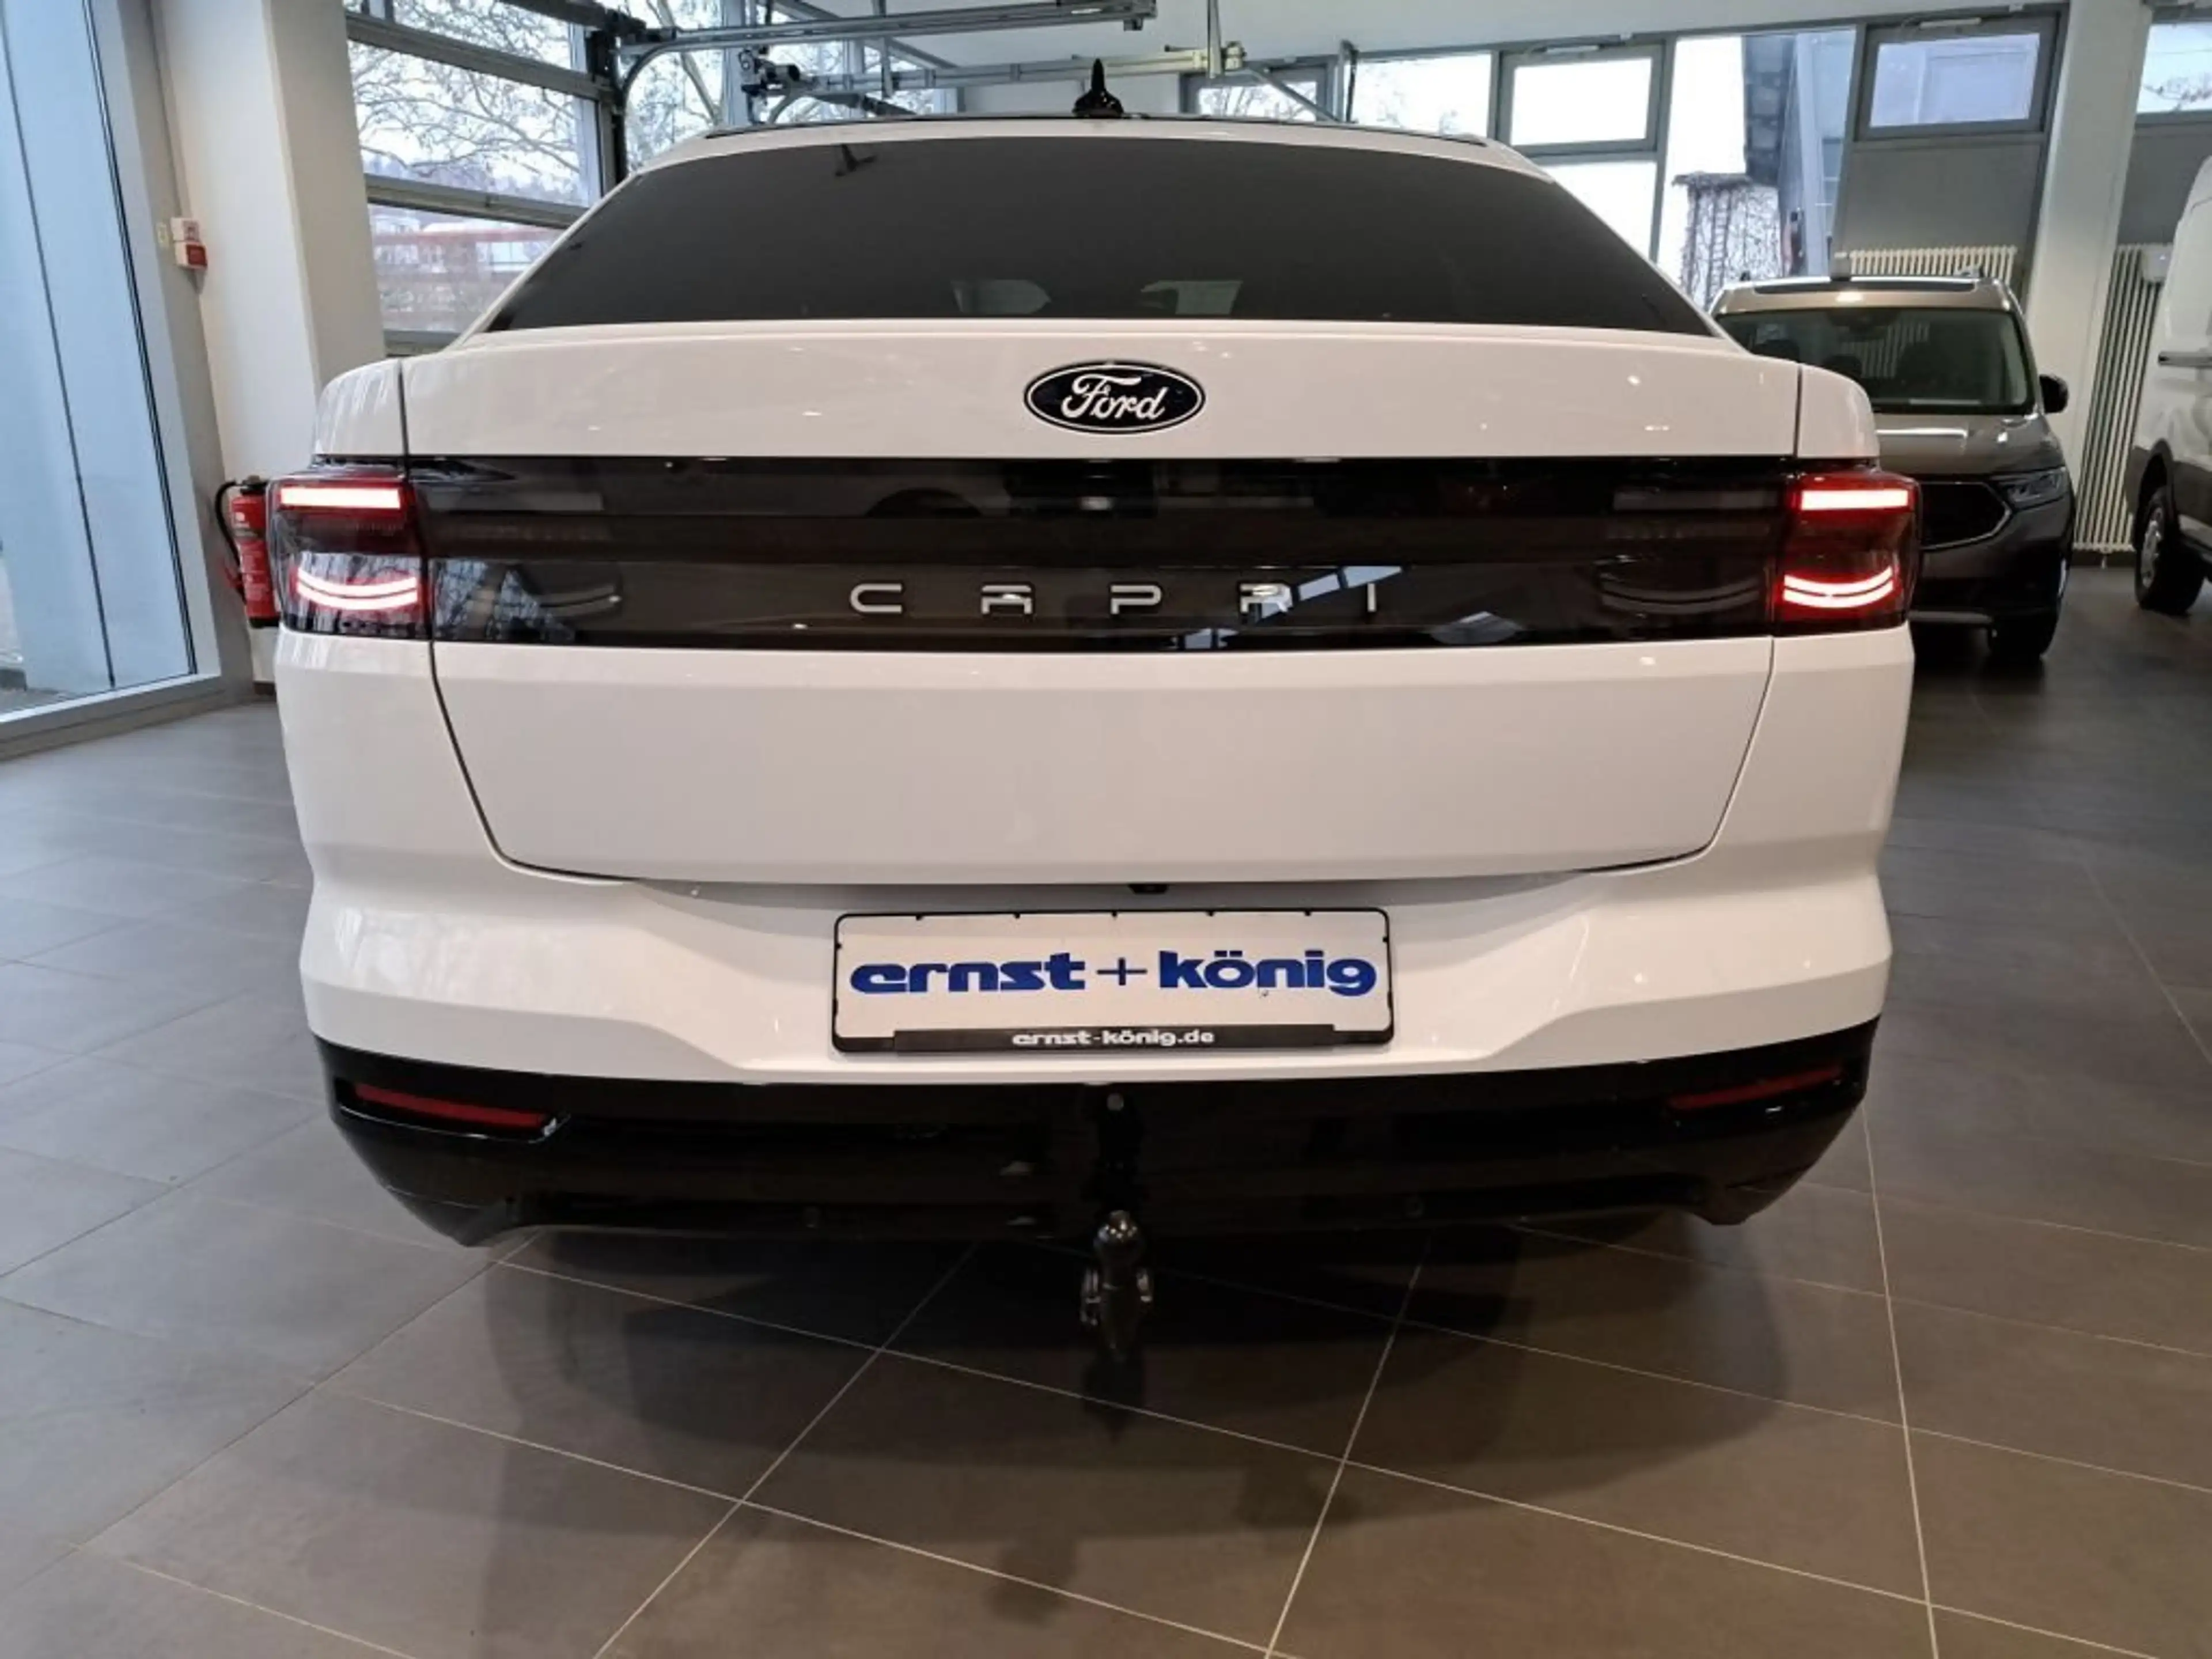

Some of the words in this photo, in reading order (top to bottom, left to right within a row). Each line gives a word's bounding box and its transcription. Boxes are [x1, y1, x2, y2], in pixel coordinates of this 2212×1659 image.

[1062, 373, 1167, 421] Ford
[850, 582, 1376, 615] CAPRI
[850, 952, 1086, 995] ernst
[1158, 950, 1377, 997] könig
[1012, 1028, 1215, 1047] ernst-könig.de
